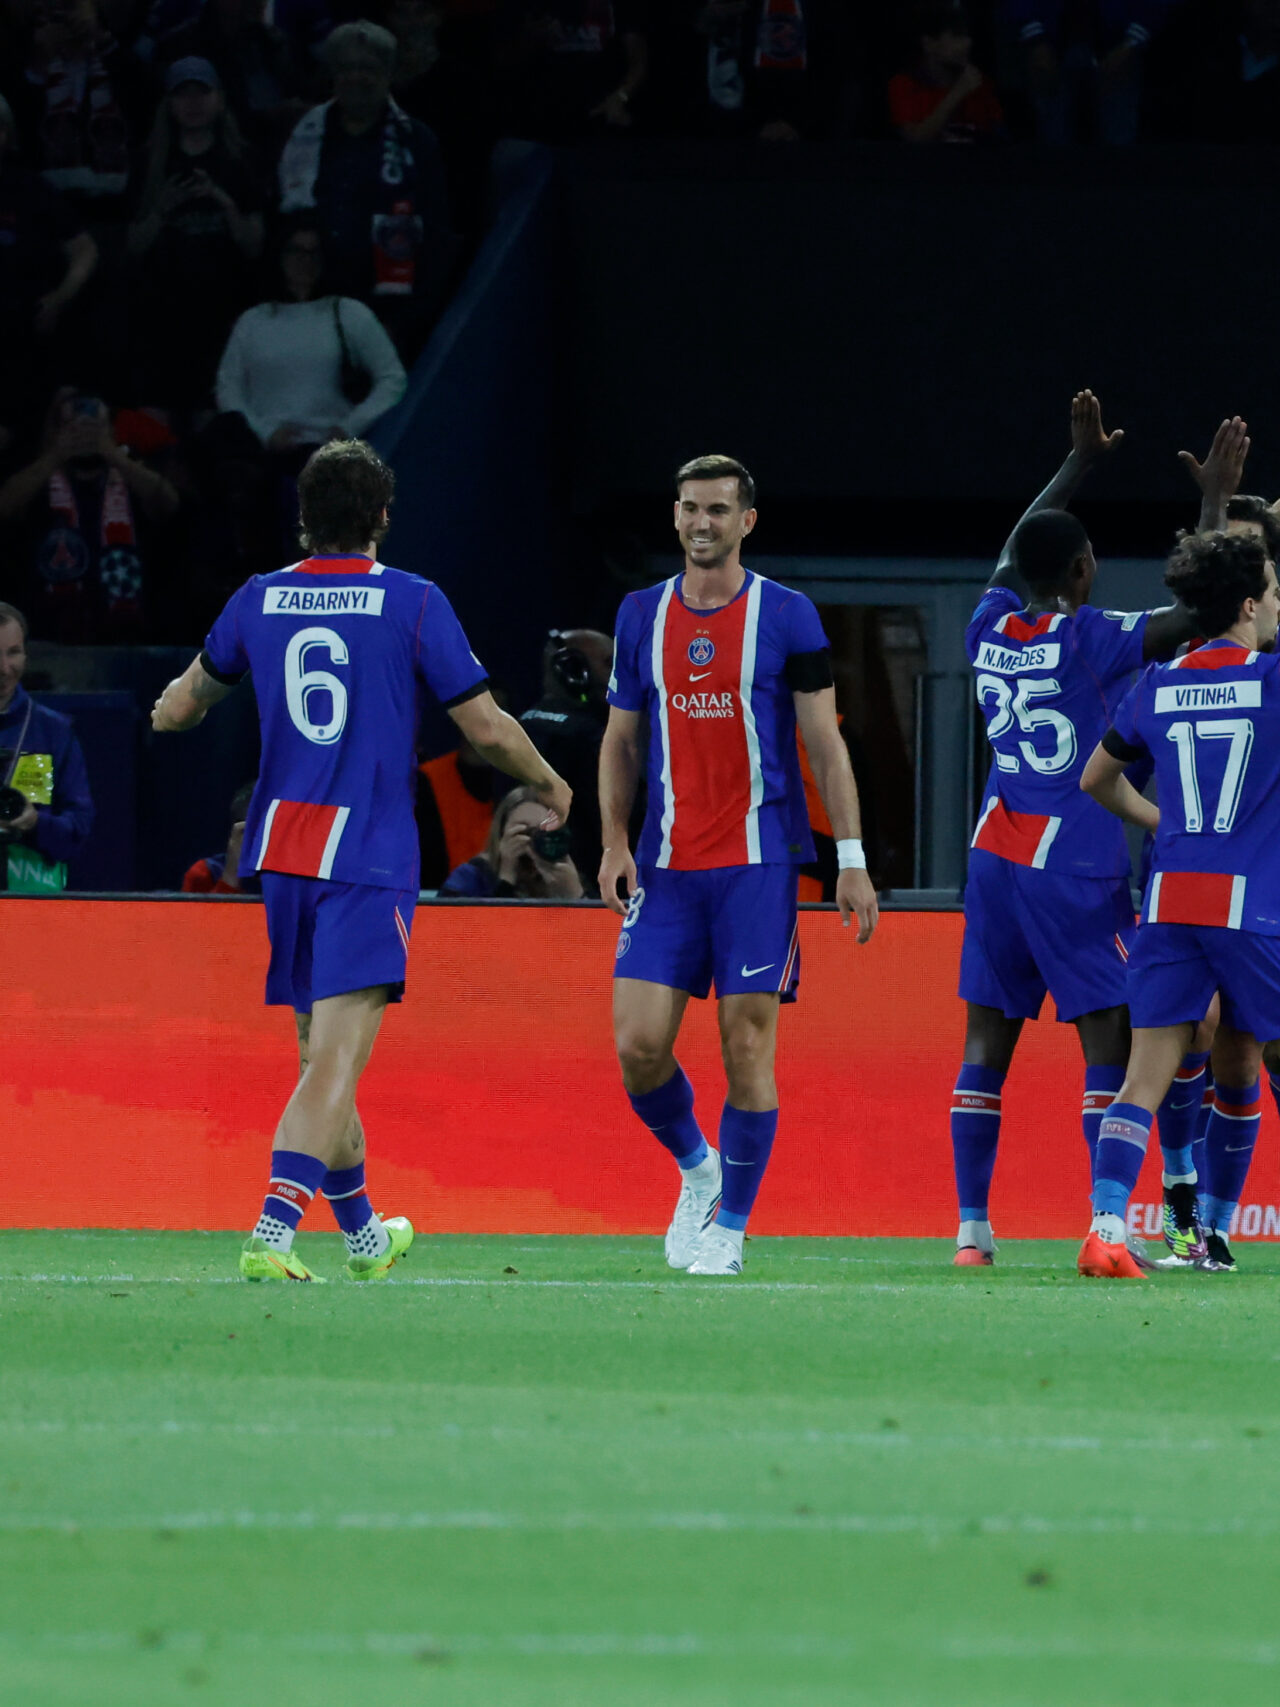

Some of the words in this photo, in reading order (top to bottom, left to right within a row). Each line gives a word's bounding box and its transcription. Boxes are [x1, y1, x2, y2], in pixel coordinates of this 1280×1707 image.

[276, 590, 369, 610] ZABARNYI
[983, 648, 1046, 671] N.MEDES
[284, 626, 349, 745] 6
[672, 692, 733, 712] QATAR
[1175, 686, 1238, 707] VITINHA
[688, 707, 735, 719] AIRWAYS
[976, 674, 1078, 774] 25
[1166, 718, 1254, 833] 17
[276, 1184, 299, 1200] PARIS
